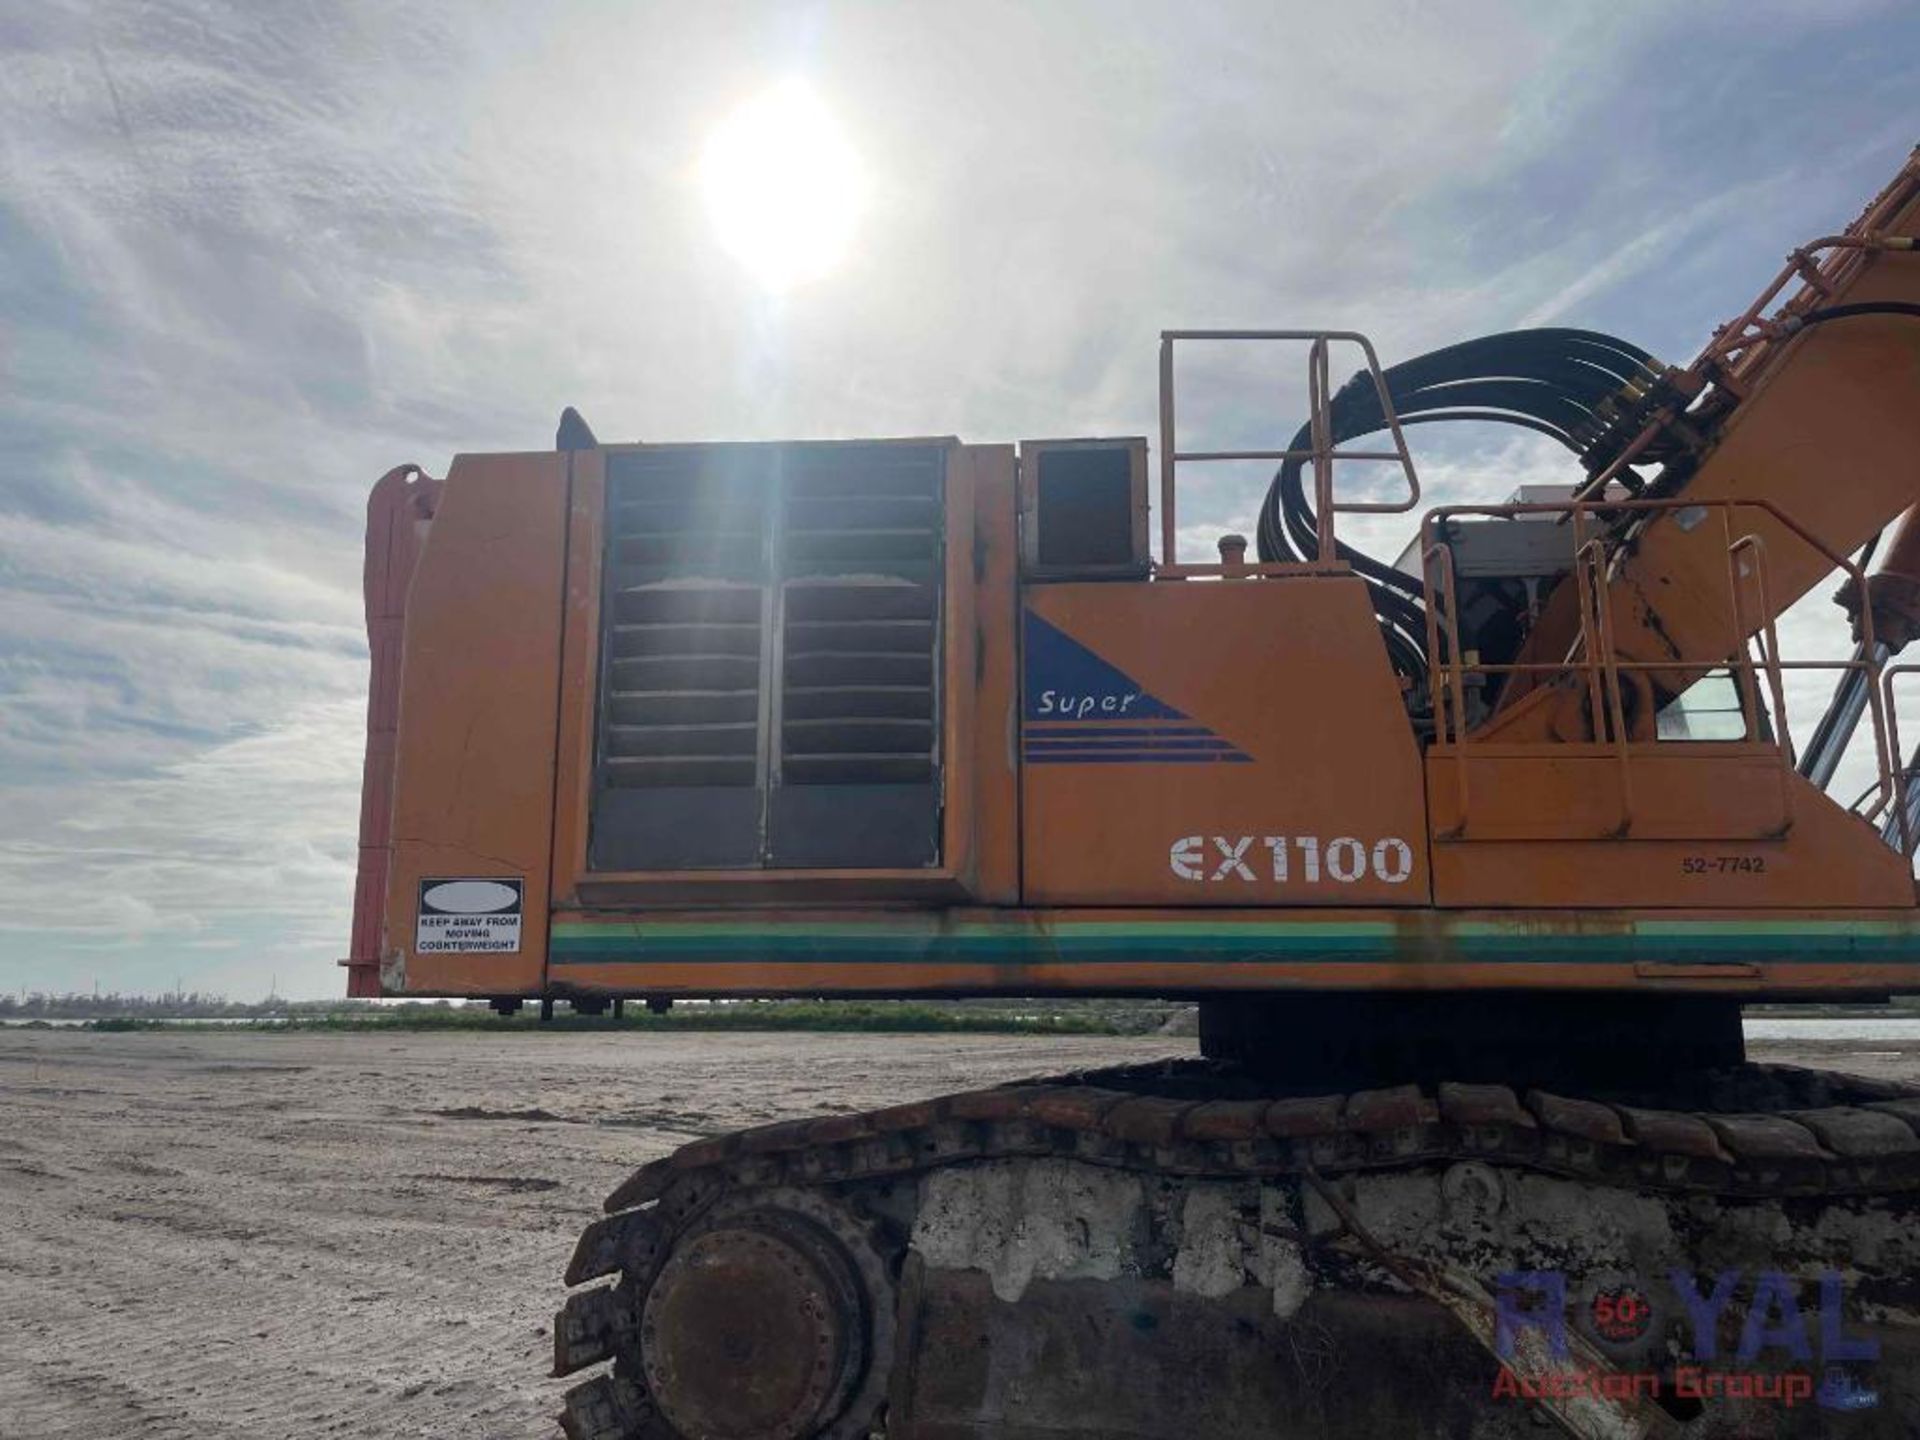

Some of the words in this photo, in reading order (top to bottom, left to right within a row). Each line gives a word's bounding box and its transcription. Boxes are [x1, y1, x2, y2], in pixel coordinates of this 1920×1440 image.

[1037, 690, 1136, 719] Super
[1169, 836, 1413, 883] EX1100
[1682, 856, 1765, 873] 52-7742
[420, 917, 450, 926] KEEP
[453, 917, 482, 926] AWAY
[486, 917, 518, 926] FROM
[445, 929, 490, 938] MOVING
[419, 941, 516, 950] COUNTERWEIGHT
